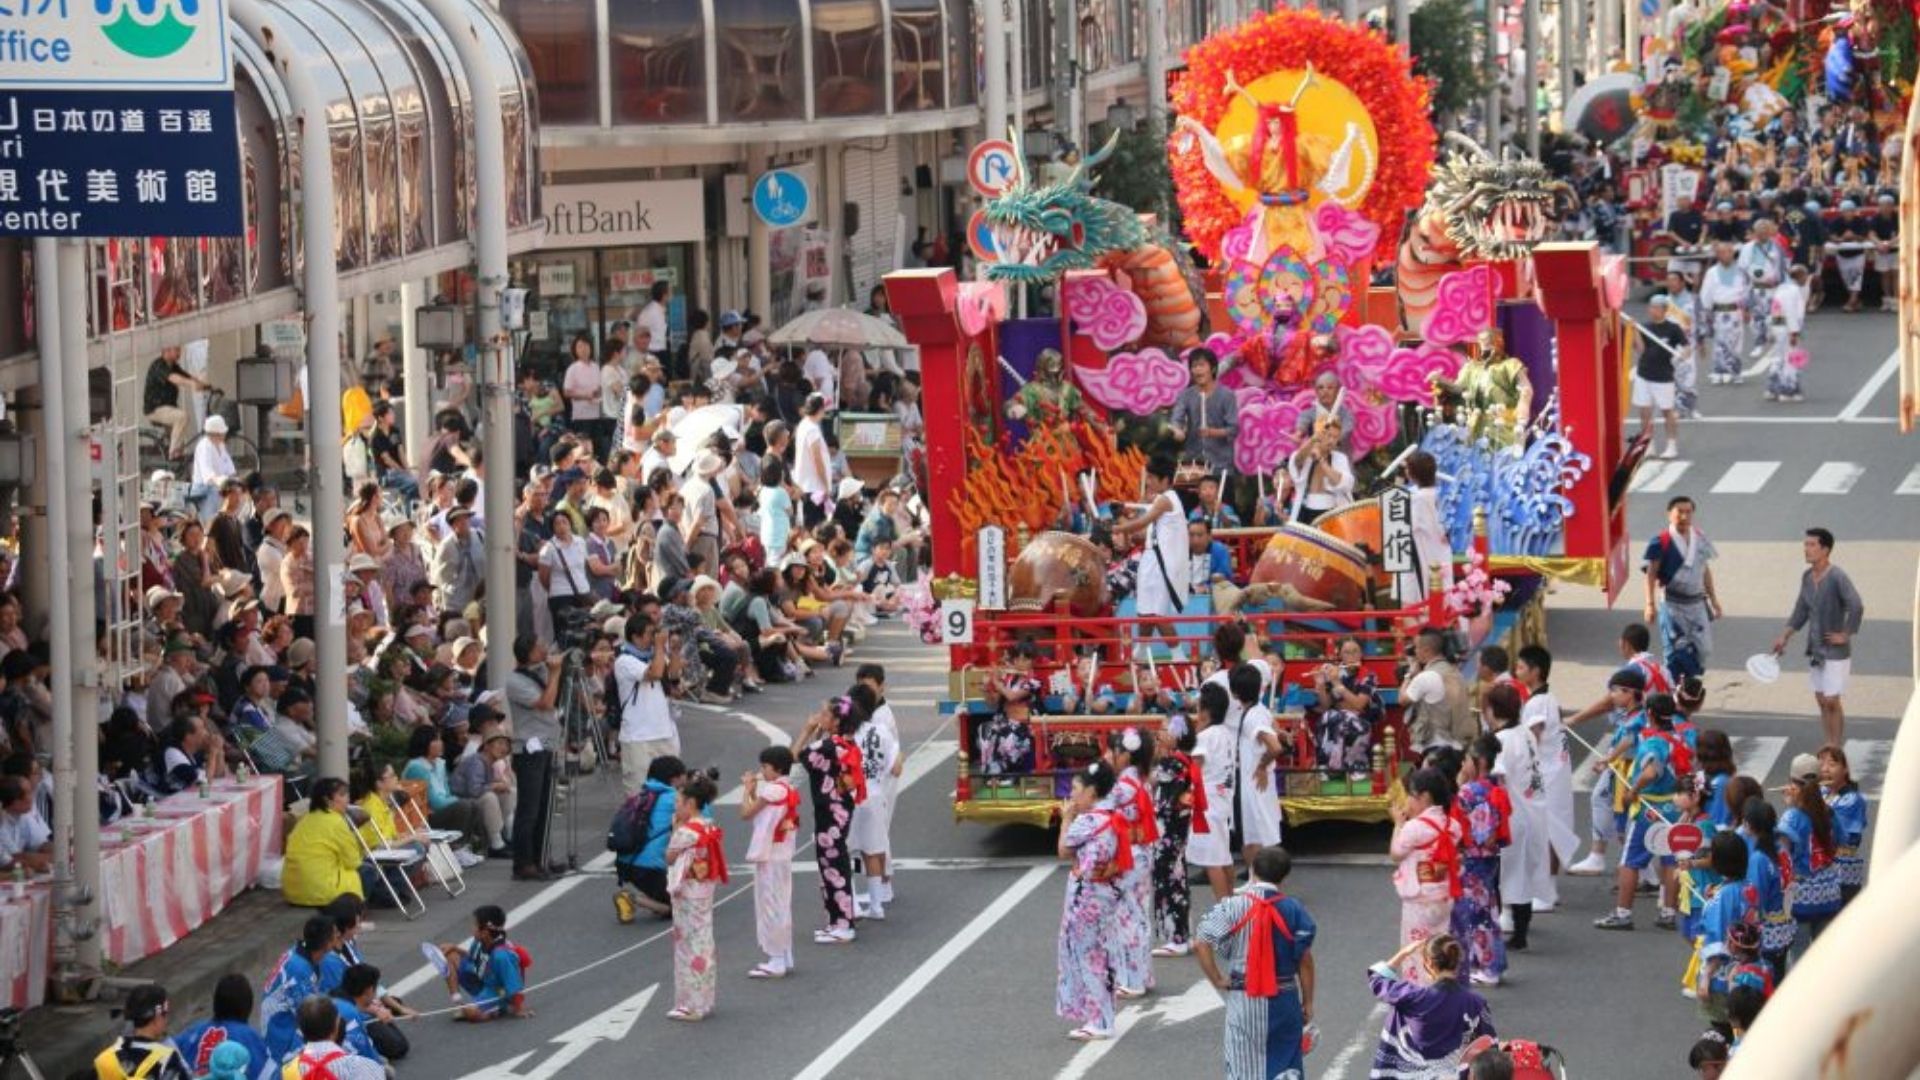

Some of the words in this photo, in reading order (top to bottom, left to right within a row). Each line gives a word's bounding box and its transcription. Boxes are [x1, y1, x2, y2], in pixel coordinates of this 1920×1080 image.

[0, 168, 218, 203] 現代美術館
[0, 207, 81, 230] enter
[948, 610, 966, 638] 9
